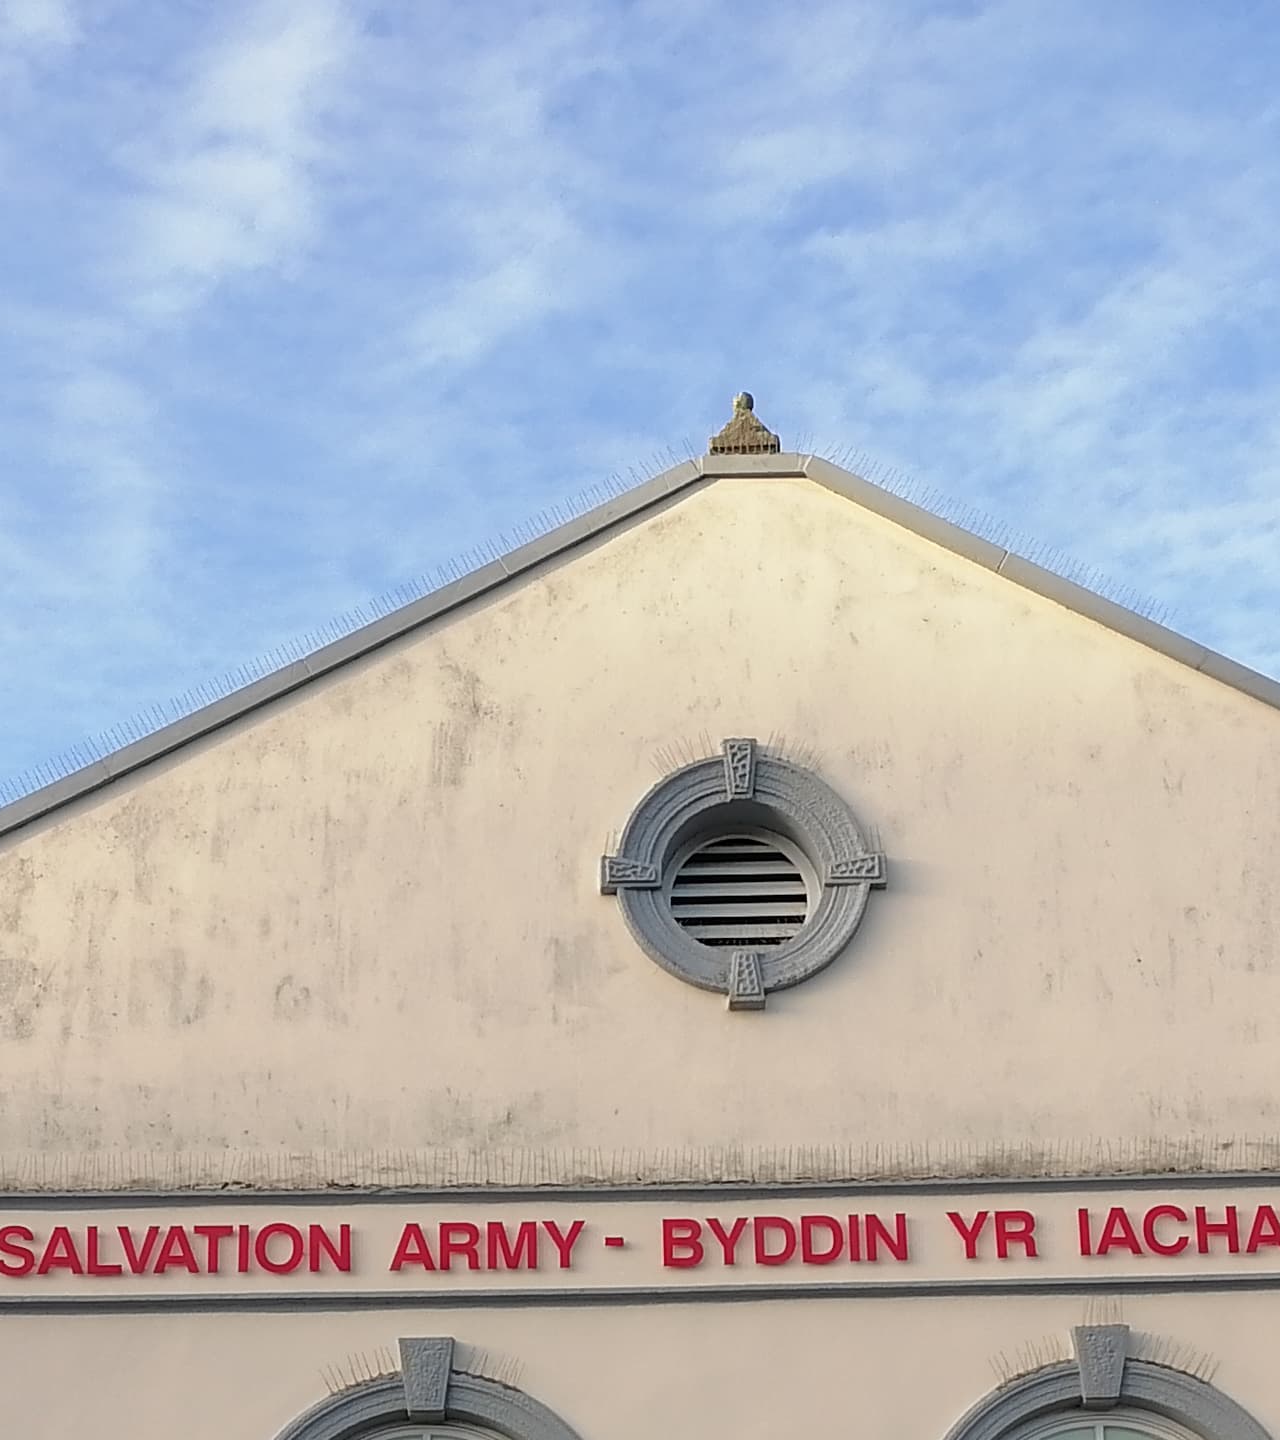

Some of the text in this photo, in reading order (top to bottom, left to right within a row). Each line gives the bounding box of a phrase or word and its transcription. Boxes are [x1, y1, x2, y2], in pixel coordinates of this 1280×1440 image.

[390, 1219, 585, 1273] ARMY
[661, 1212, 909, 1270] BYDDIN
[945, 1209, 1038, 1261] YR
